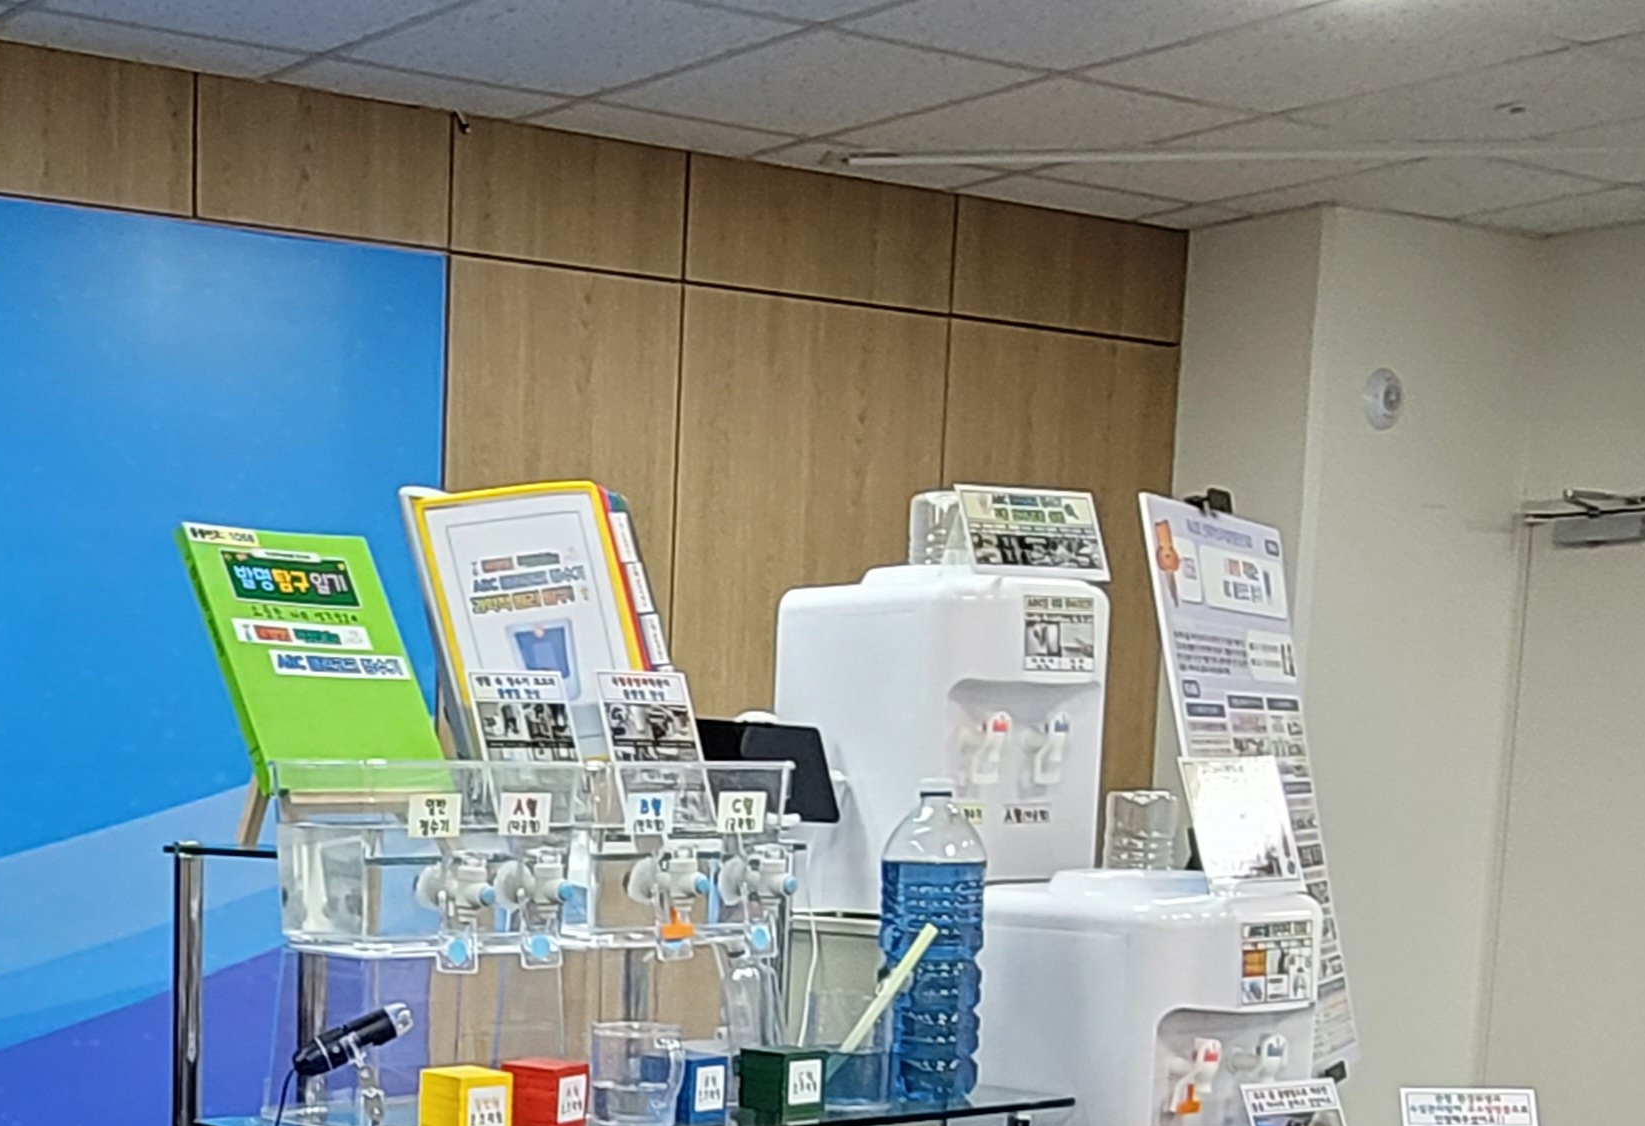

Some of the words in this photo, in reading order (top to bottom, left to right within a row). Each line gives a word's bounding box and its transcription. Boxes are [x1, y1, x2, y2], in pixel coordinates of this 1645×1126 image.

[425, 798, 447, 816] 일반
[512, 798, 539, 818] A형
[640, 797, 662, 817] B형
[731, 796, 754, 816] C형
[418, 818, 450, 836] 정수기
